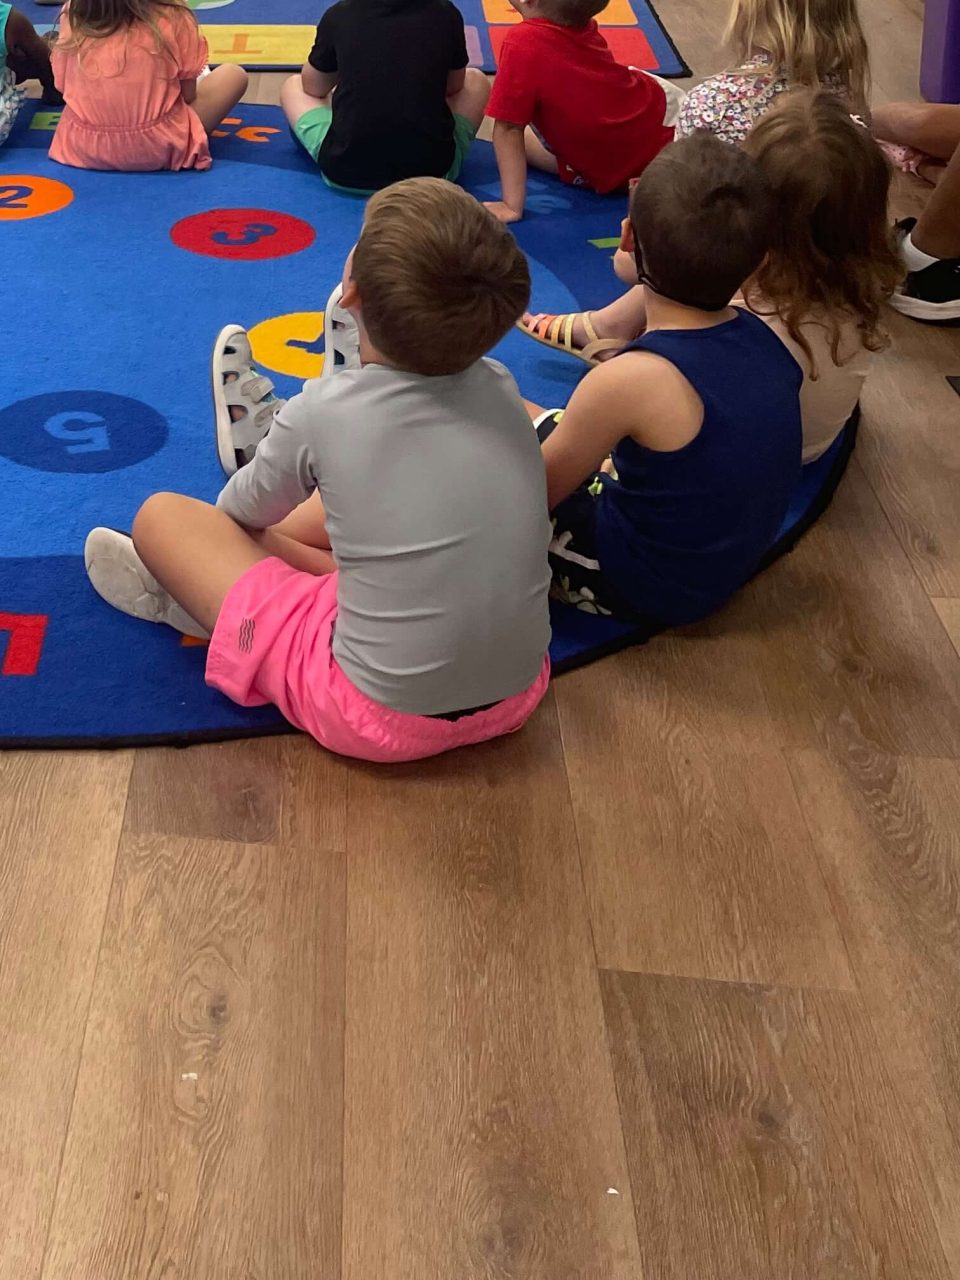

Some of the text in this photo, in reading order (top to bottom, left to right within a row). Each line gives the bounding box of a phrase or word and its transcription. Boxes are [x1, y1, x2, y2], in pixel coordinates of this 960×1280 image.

[213, 33, 263, 54] T
[211, 223, 277, 246] 3
[44, 410, 111, 455] 5
